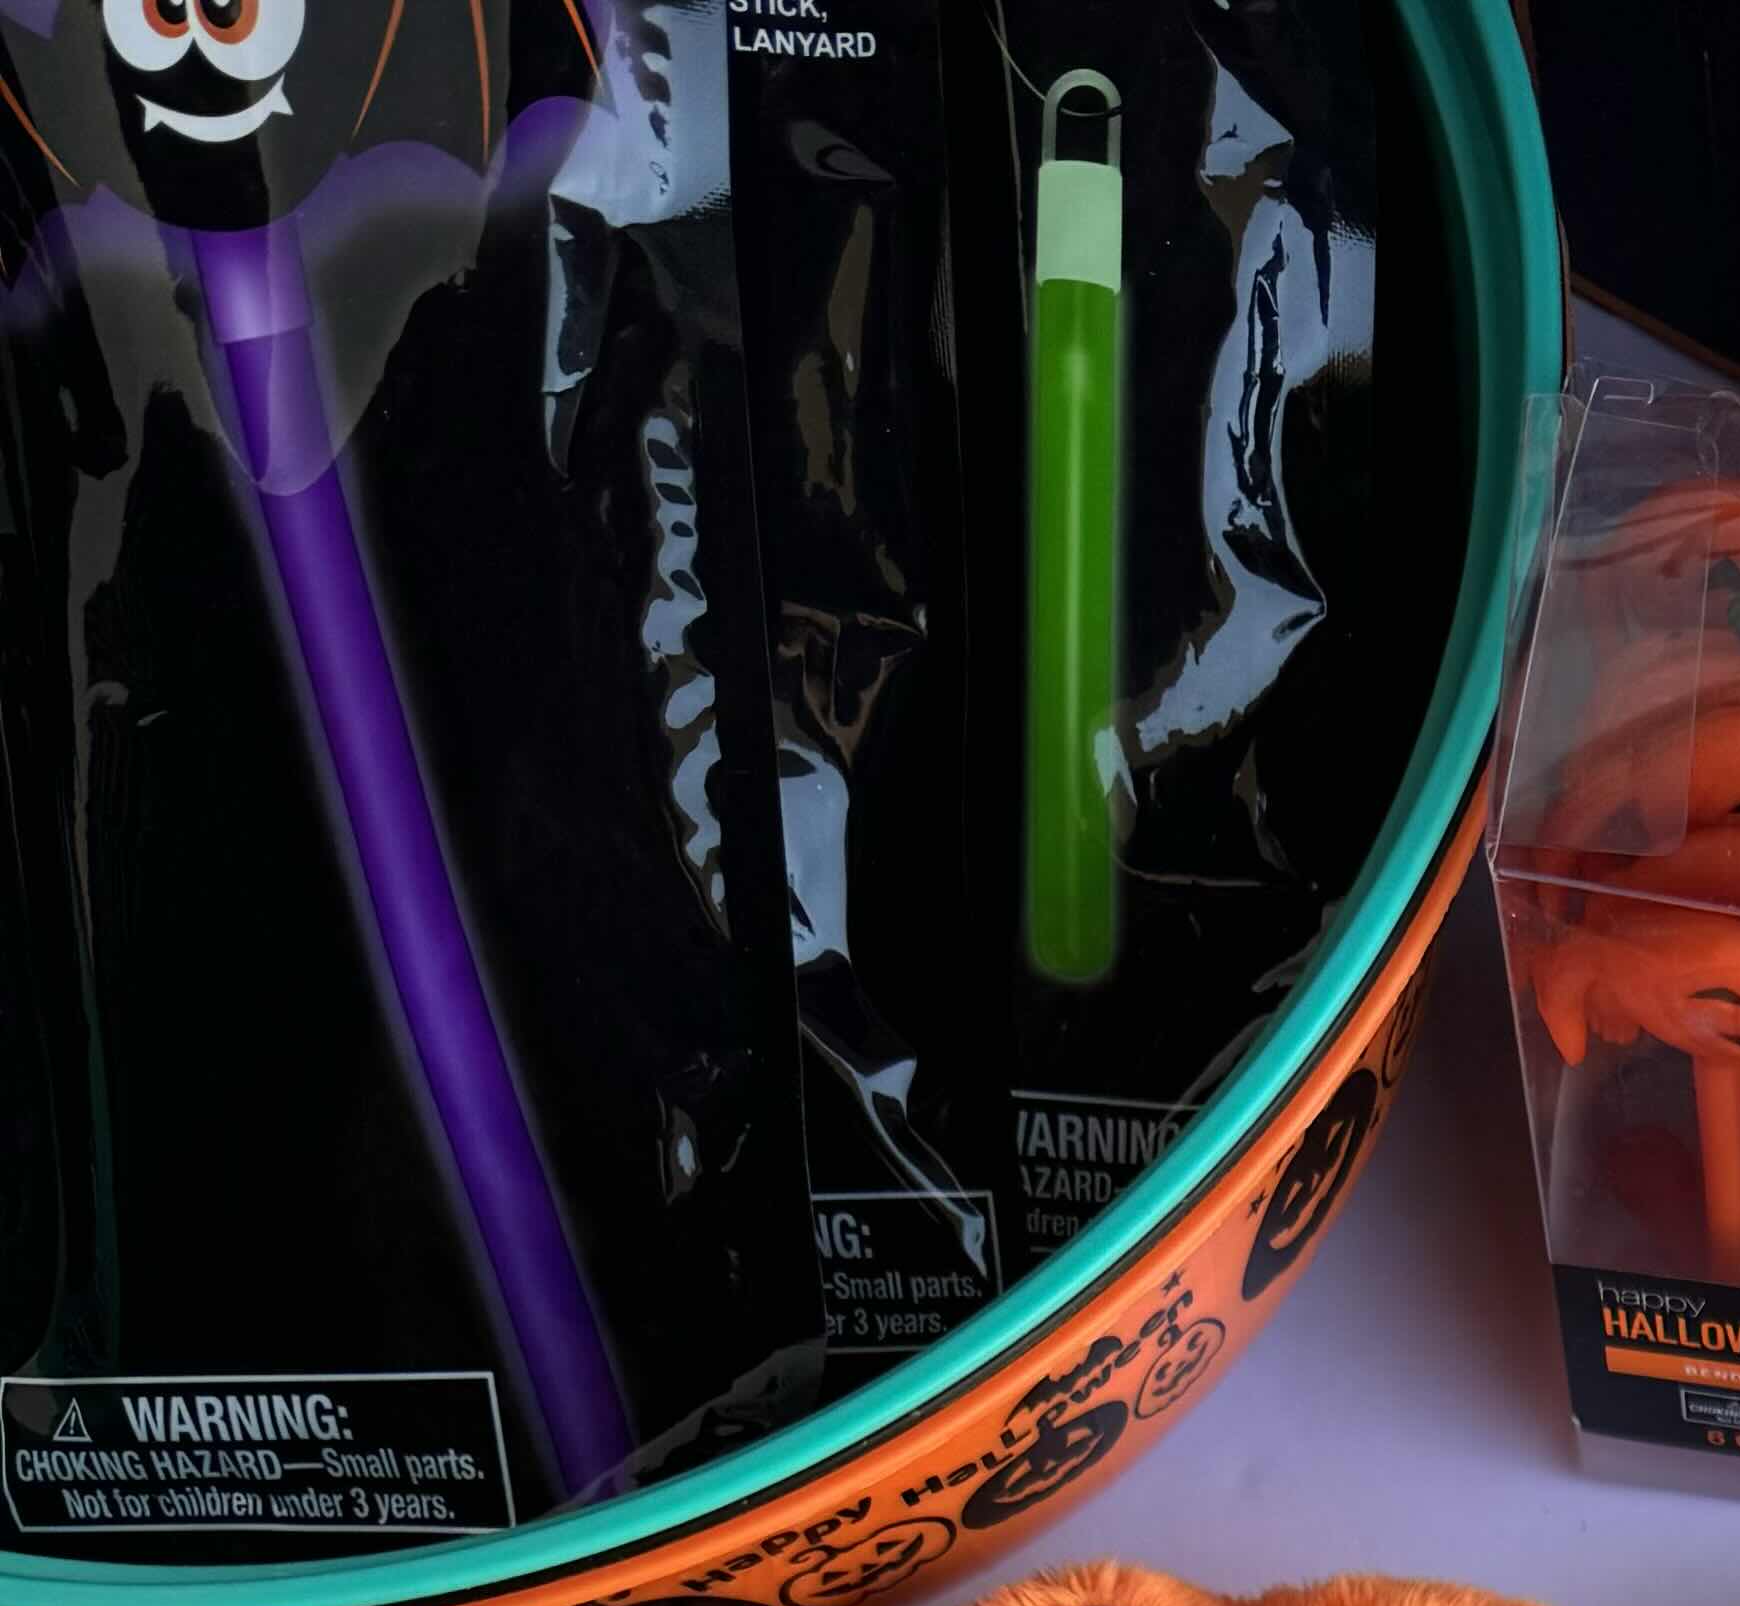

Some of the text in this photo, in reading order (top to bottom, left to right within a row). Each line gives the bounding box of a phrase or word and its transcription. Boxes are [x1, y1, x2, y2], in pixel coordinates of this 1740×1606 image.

[734, 26, 876, 58] LANYARD
[909, 1273, 983, 1308] parts.
[1598, 1279, 1706, 1319] happy
[853, 1308, 870, 1337] 3
[875, 1310, 948, 1341] years.
[122, 1393, 354, 1443] WARNING:
[15, 1448, 143, 1482] CHOKING
[405, 1449, 485, 1485] parts.
[62, 1485, 456, 1525] Not for children under 3 years.
